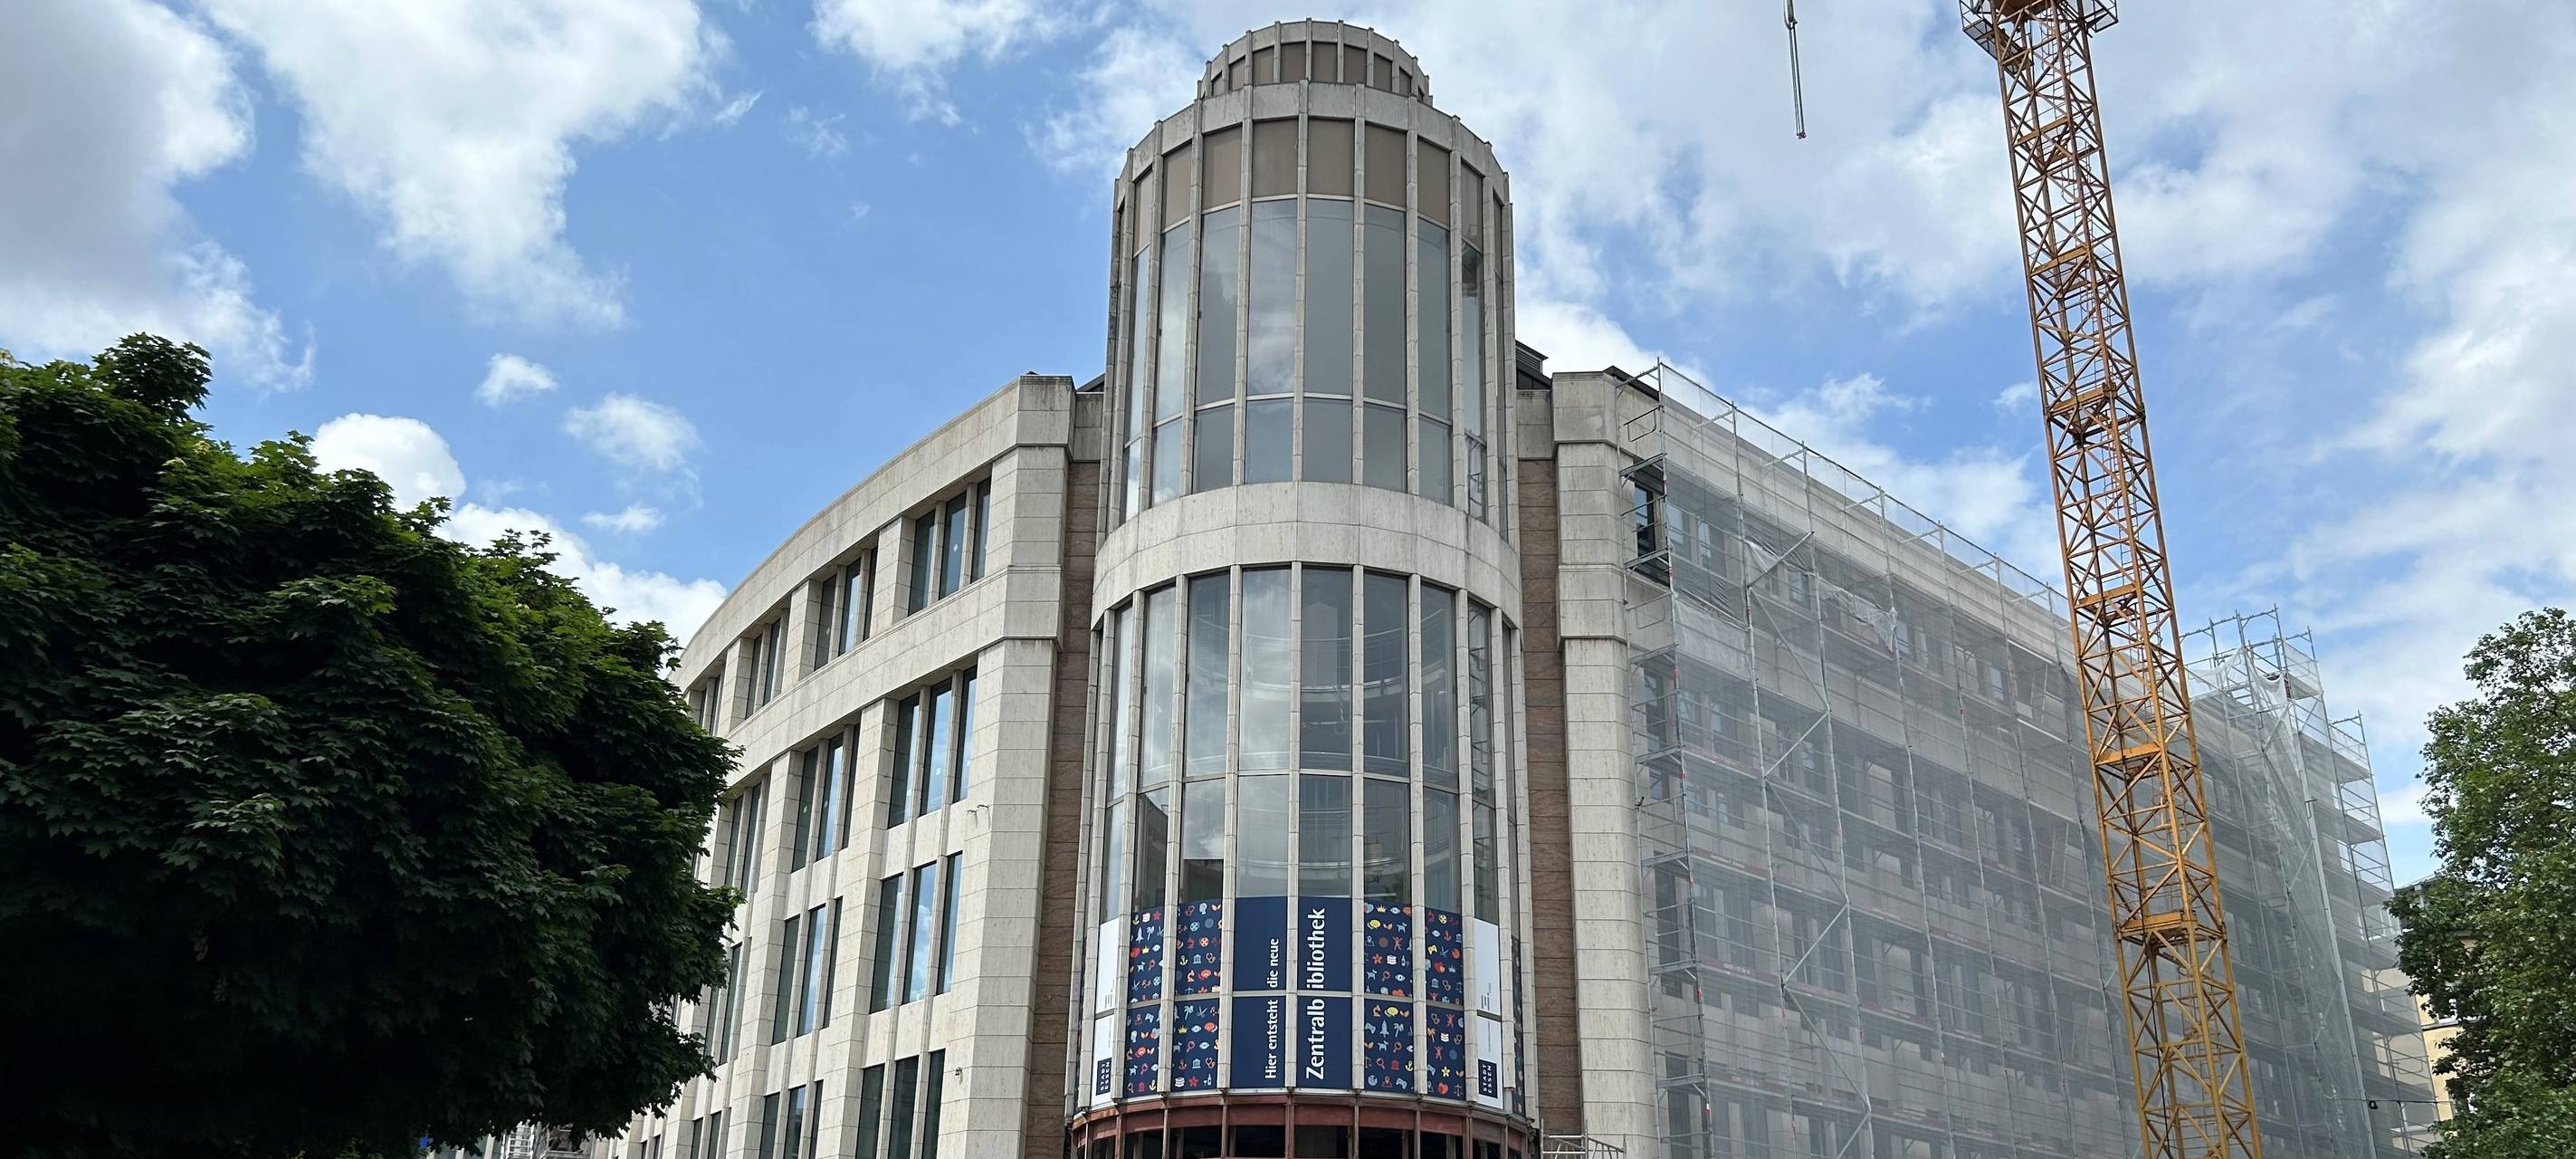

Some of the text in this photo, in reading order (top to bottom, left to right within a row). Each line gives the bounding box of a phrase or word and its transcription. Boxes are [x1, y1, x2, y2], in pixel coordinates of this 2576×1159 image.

[1264, 938, 1280, 1078] Hier entsteht die neue
